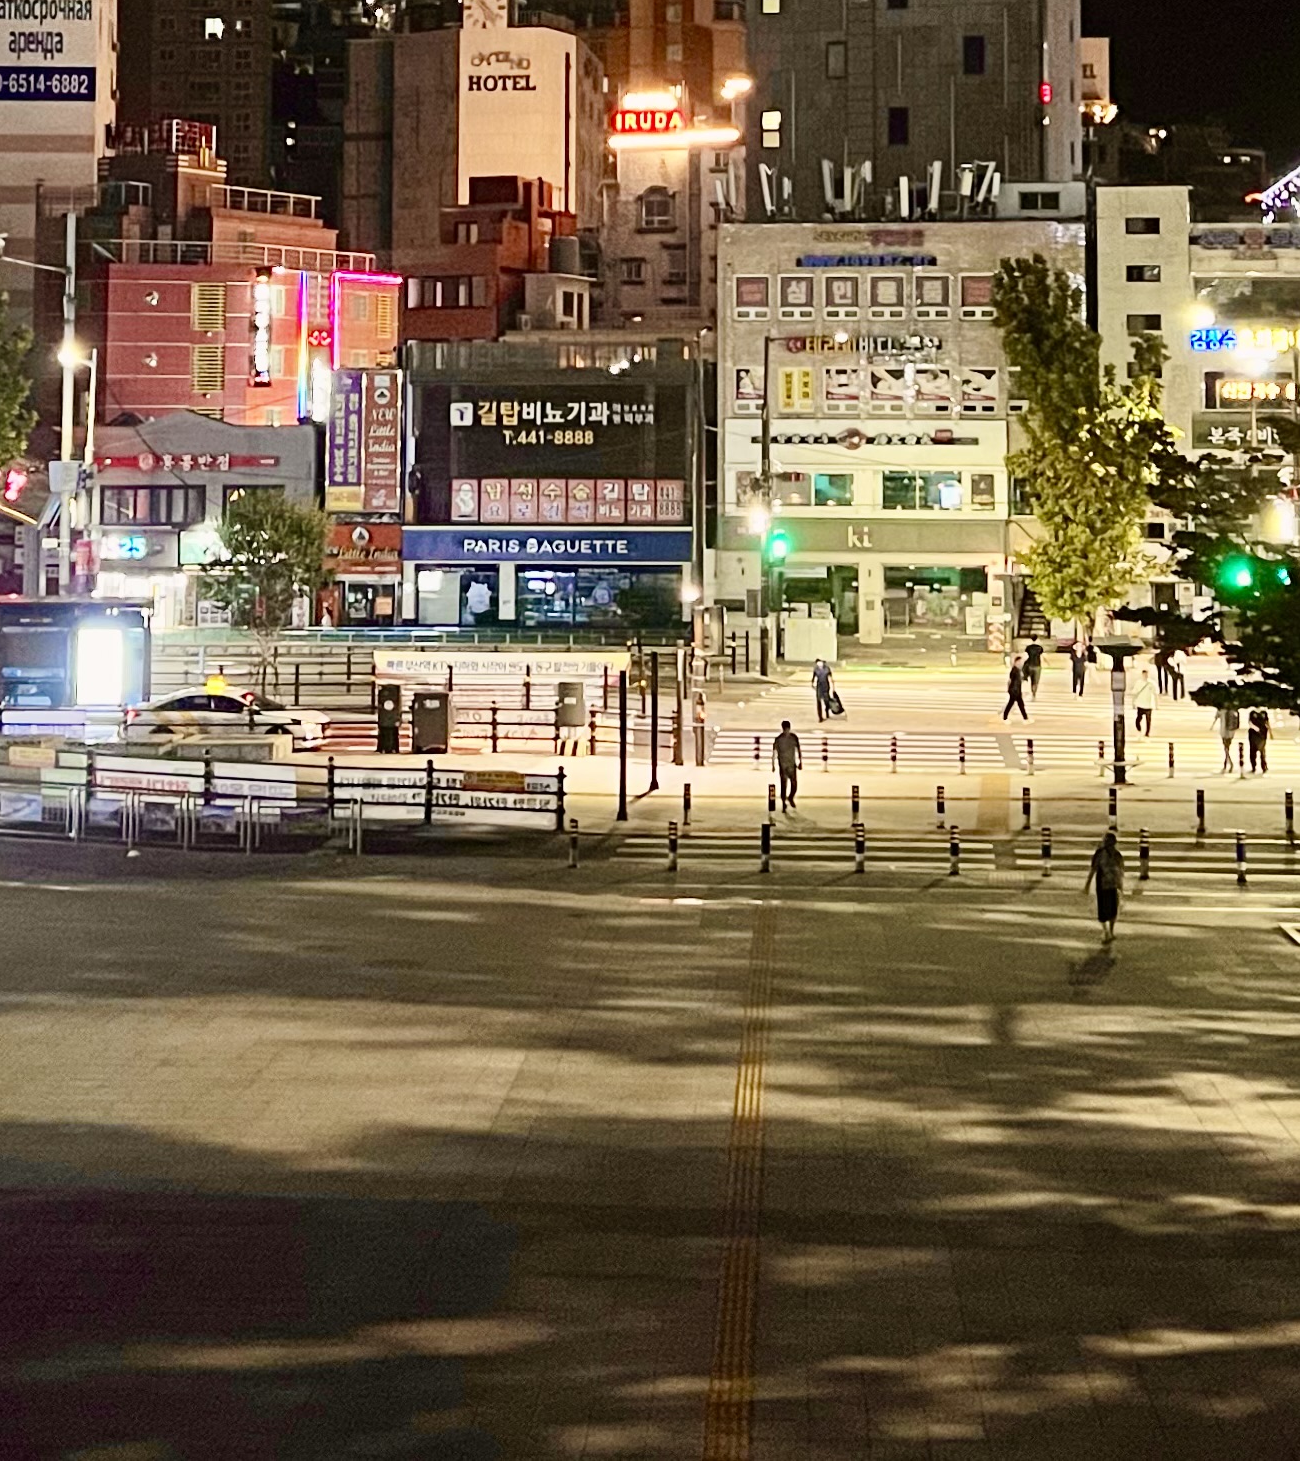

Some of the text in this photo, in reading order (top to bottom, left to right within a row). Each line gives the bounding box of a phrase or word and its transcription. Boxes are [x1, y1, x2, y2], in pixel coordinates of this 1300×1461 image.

[8, 30, 63, 60] аренда
[467, 74, 537, 93] HOTEL
[615, 111, 683, 131] IRUDA
[478, 400, 611, 427] 길탑비뇨기과
[368, 424, 395, 438] Little
[502, 429, 595, 446] T.441-8888
[367, 439, 396, 453] India
[602, 483, 650, 501] 길탑
[658, 501, 682, 516] 8888
[337, 546, 398, 561] Little India
[463, 537, 629, 554] PARIS BAGUETTE
